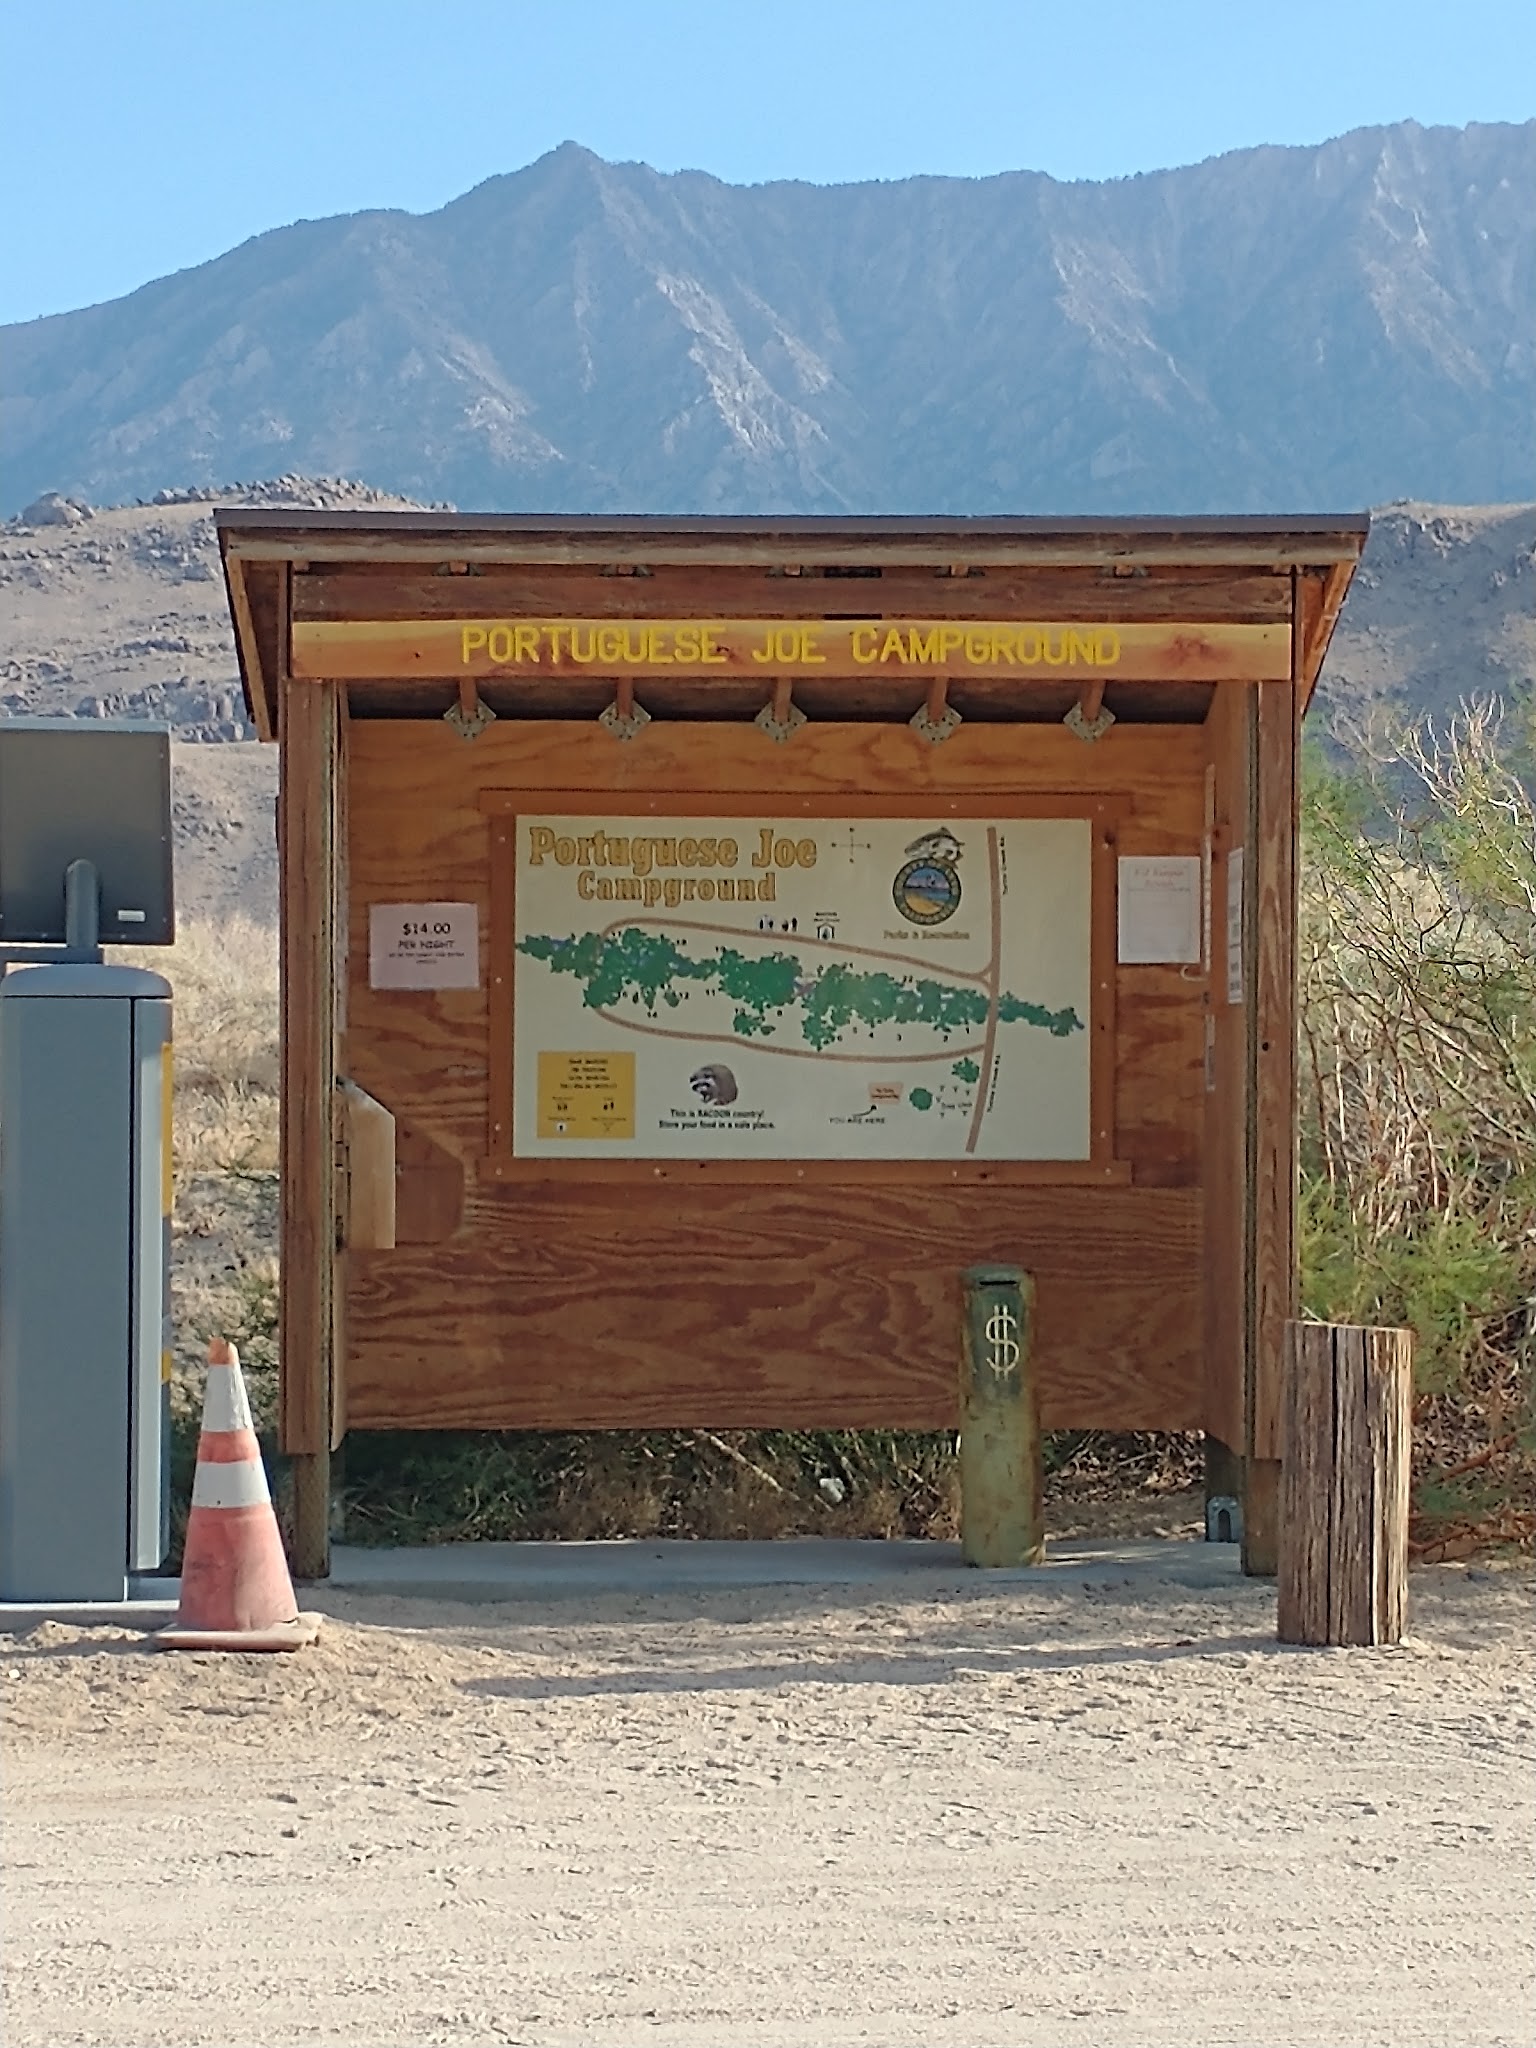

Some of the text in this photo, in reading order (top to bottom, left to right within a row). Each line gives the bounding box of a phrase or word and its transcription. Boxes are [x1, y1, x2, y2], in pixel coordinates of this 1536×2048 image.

[462, 626, 1122, 666] PORTUGUESE JOE CAMPGROUND
[529, 826, 818, 876] Portuguese Joe
[577, 870, 777, 907] Campground
[403, 922, 451, 936] $14.00
[985, 1304, 1020, 1381] $
